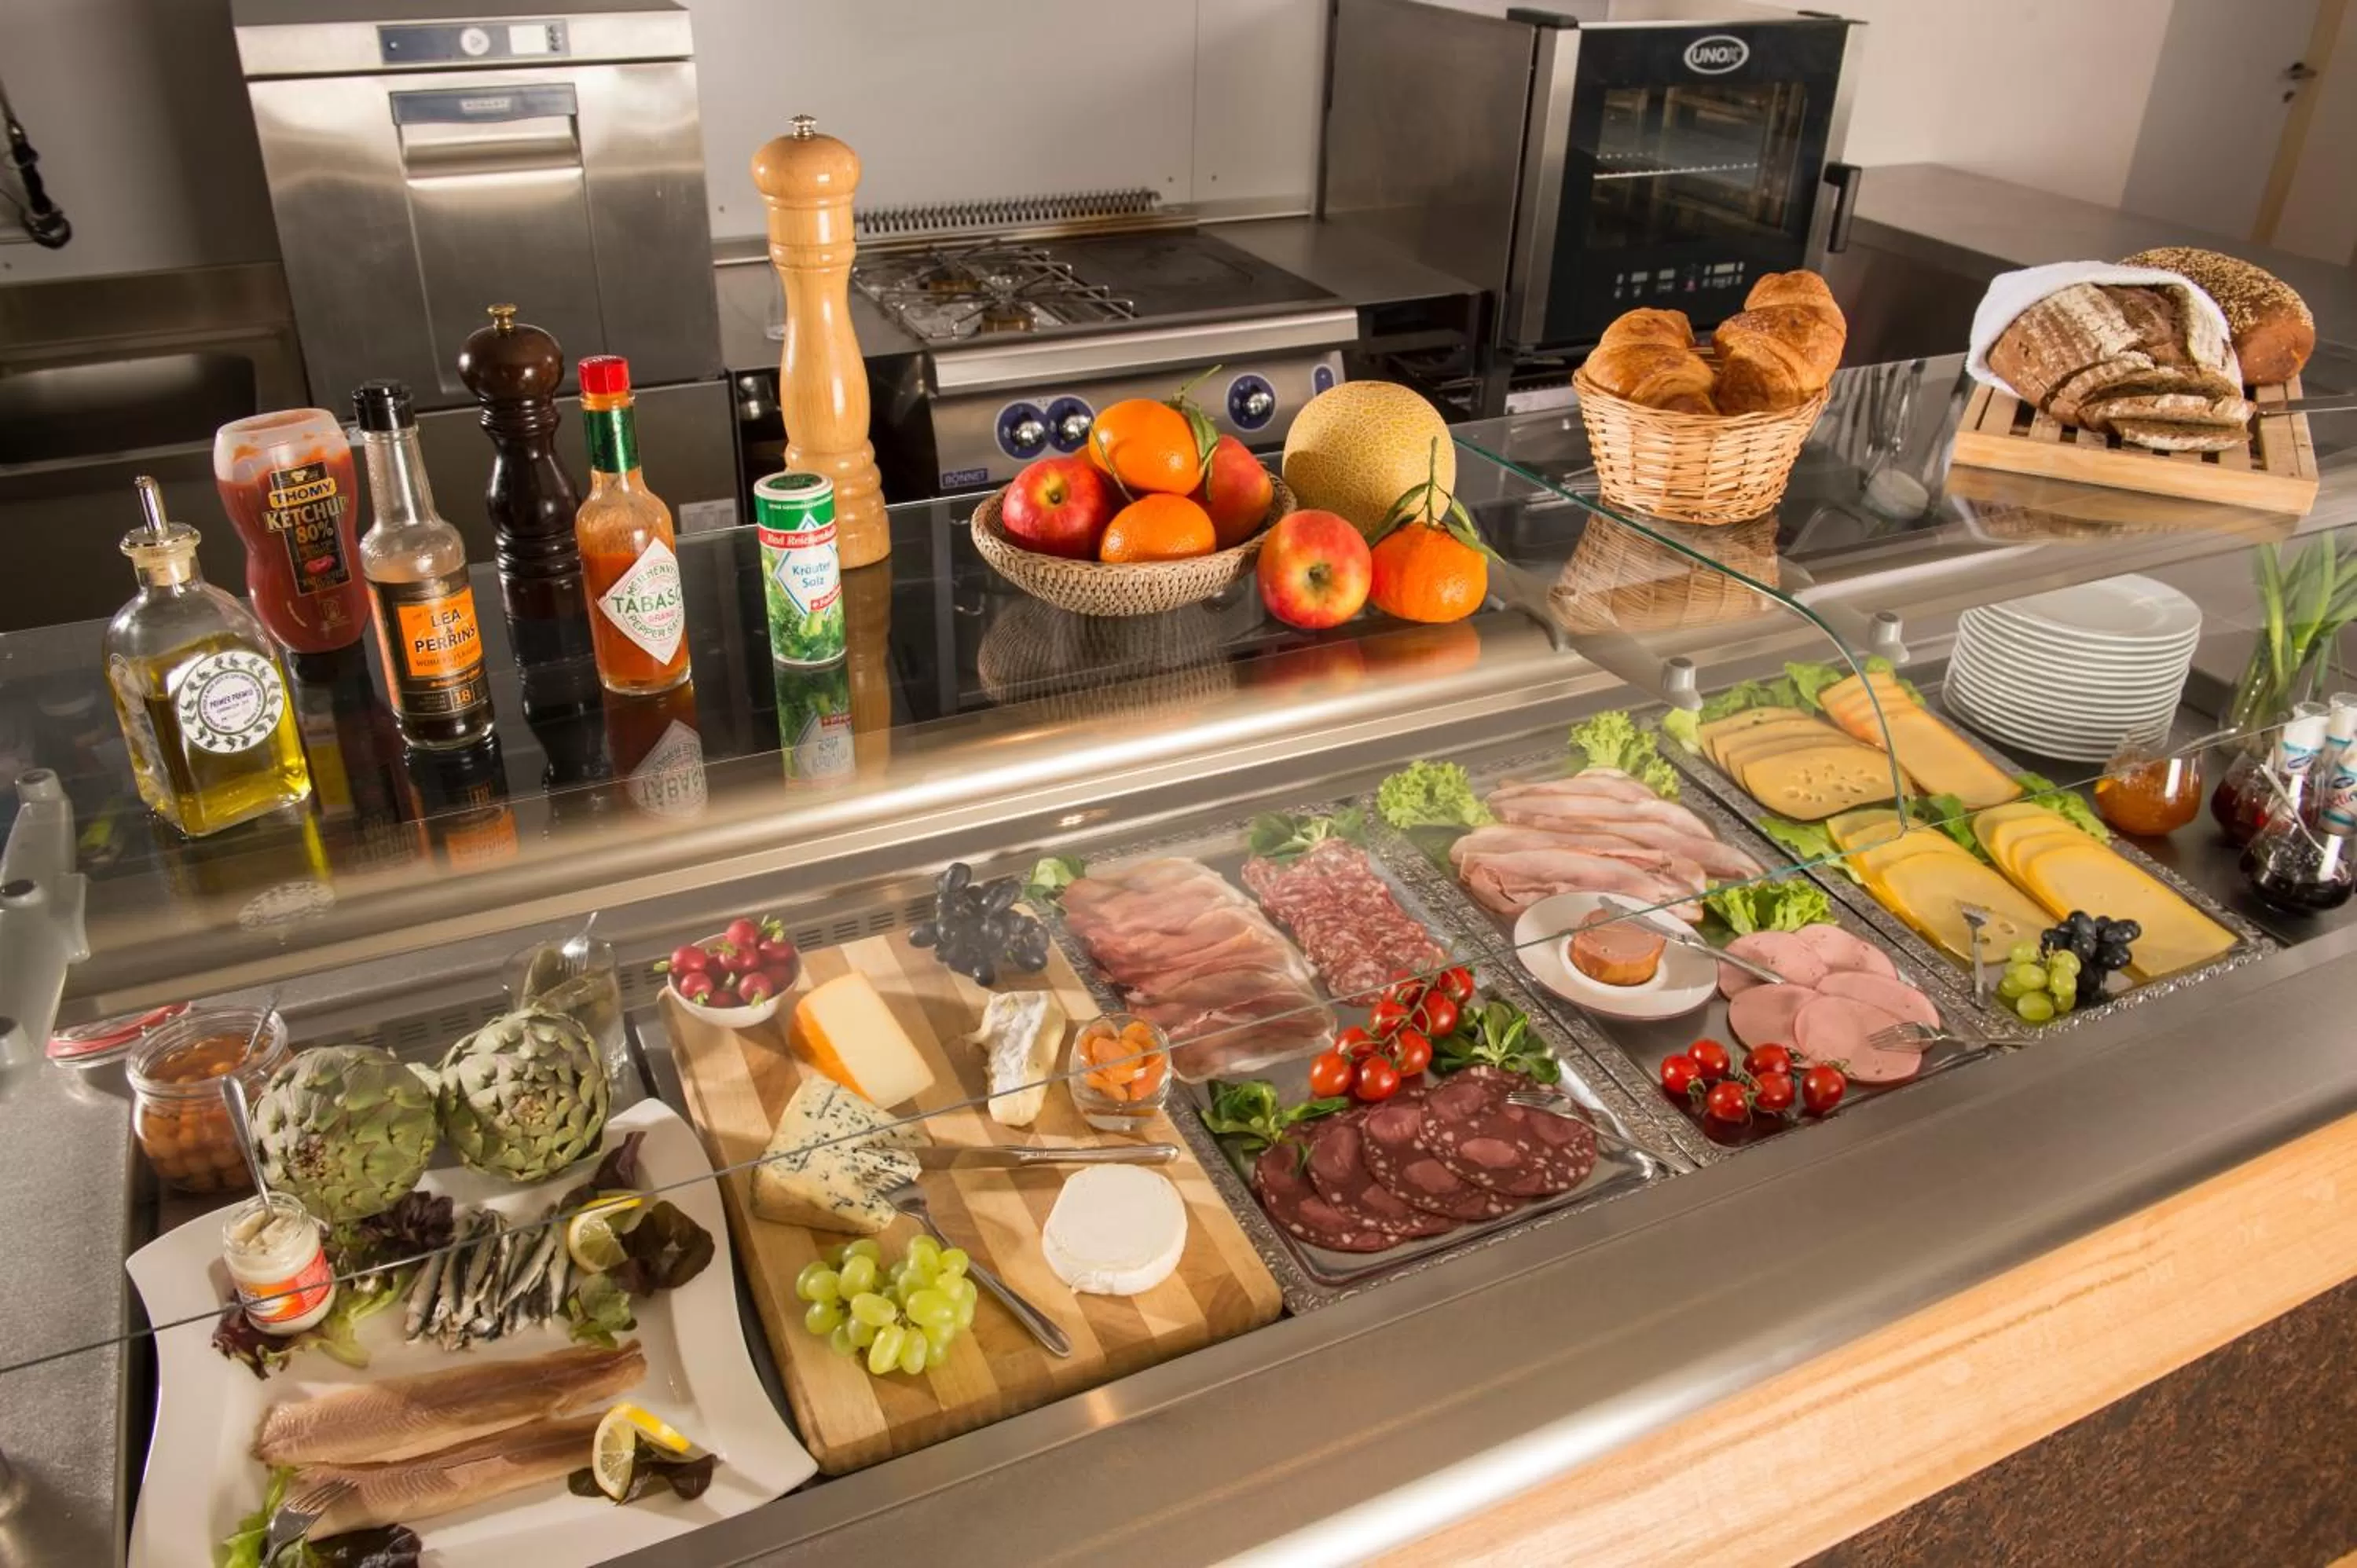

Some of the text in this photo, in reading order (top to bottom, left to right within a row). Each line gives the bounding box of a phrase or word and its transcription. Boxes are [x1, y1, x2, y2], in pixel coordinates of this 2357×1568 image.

[271, 483, 330, 503] THOMY
[266, 496, 347, 530] KETCHUP
[792, 561, 830, 575] Kräuter
[802, 577, 824, 588] Salz
[431, 608, 461, 627] LEA
[414, 623, 475, 654] PERRINS
